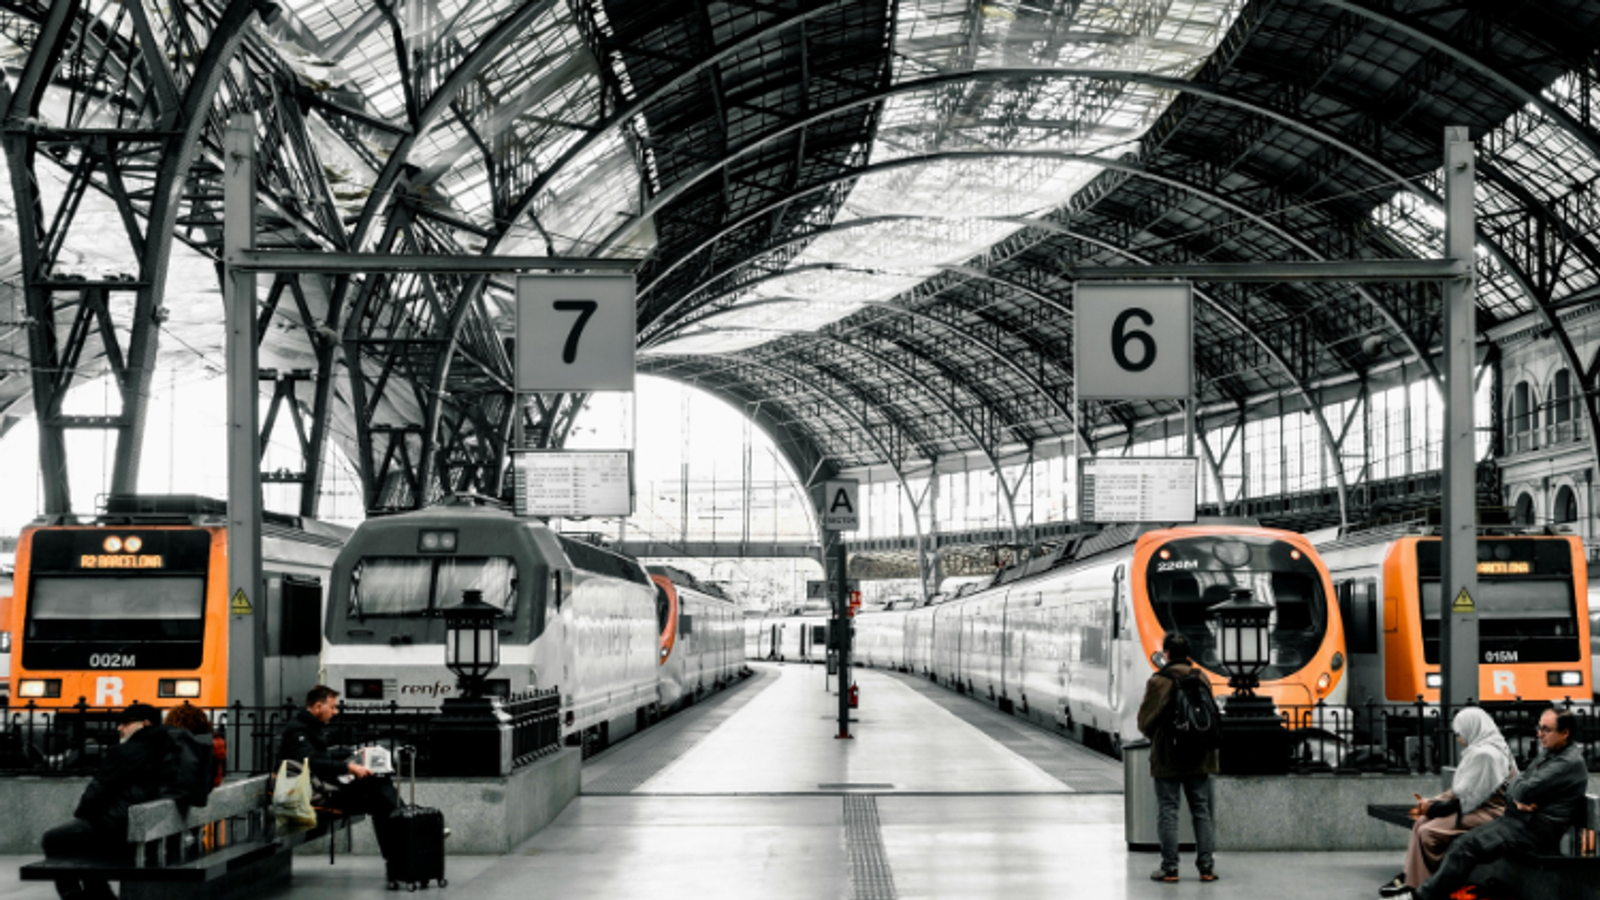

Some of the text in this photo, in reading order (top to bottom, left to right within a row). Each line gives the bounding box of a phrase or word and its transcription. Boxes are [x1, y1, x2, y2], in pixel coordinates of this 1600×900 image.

[553, 300, 598, 364] 7
[1111, 308, 1157, 372] 6
[830, 487, 853, 513] A
[98, 554, 162, 569] BARCELONA
[89, 652, 136, 668] 002M
[1484, 651, 1518, 662] 015M
[96, 676, 124, 707] R
[400, 680, 451, 699] renfe
[1493, 669, 1516, 695] R
